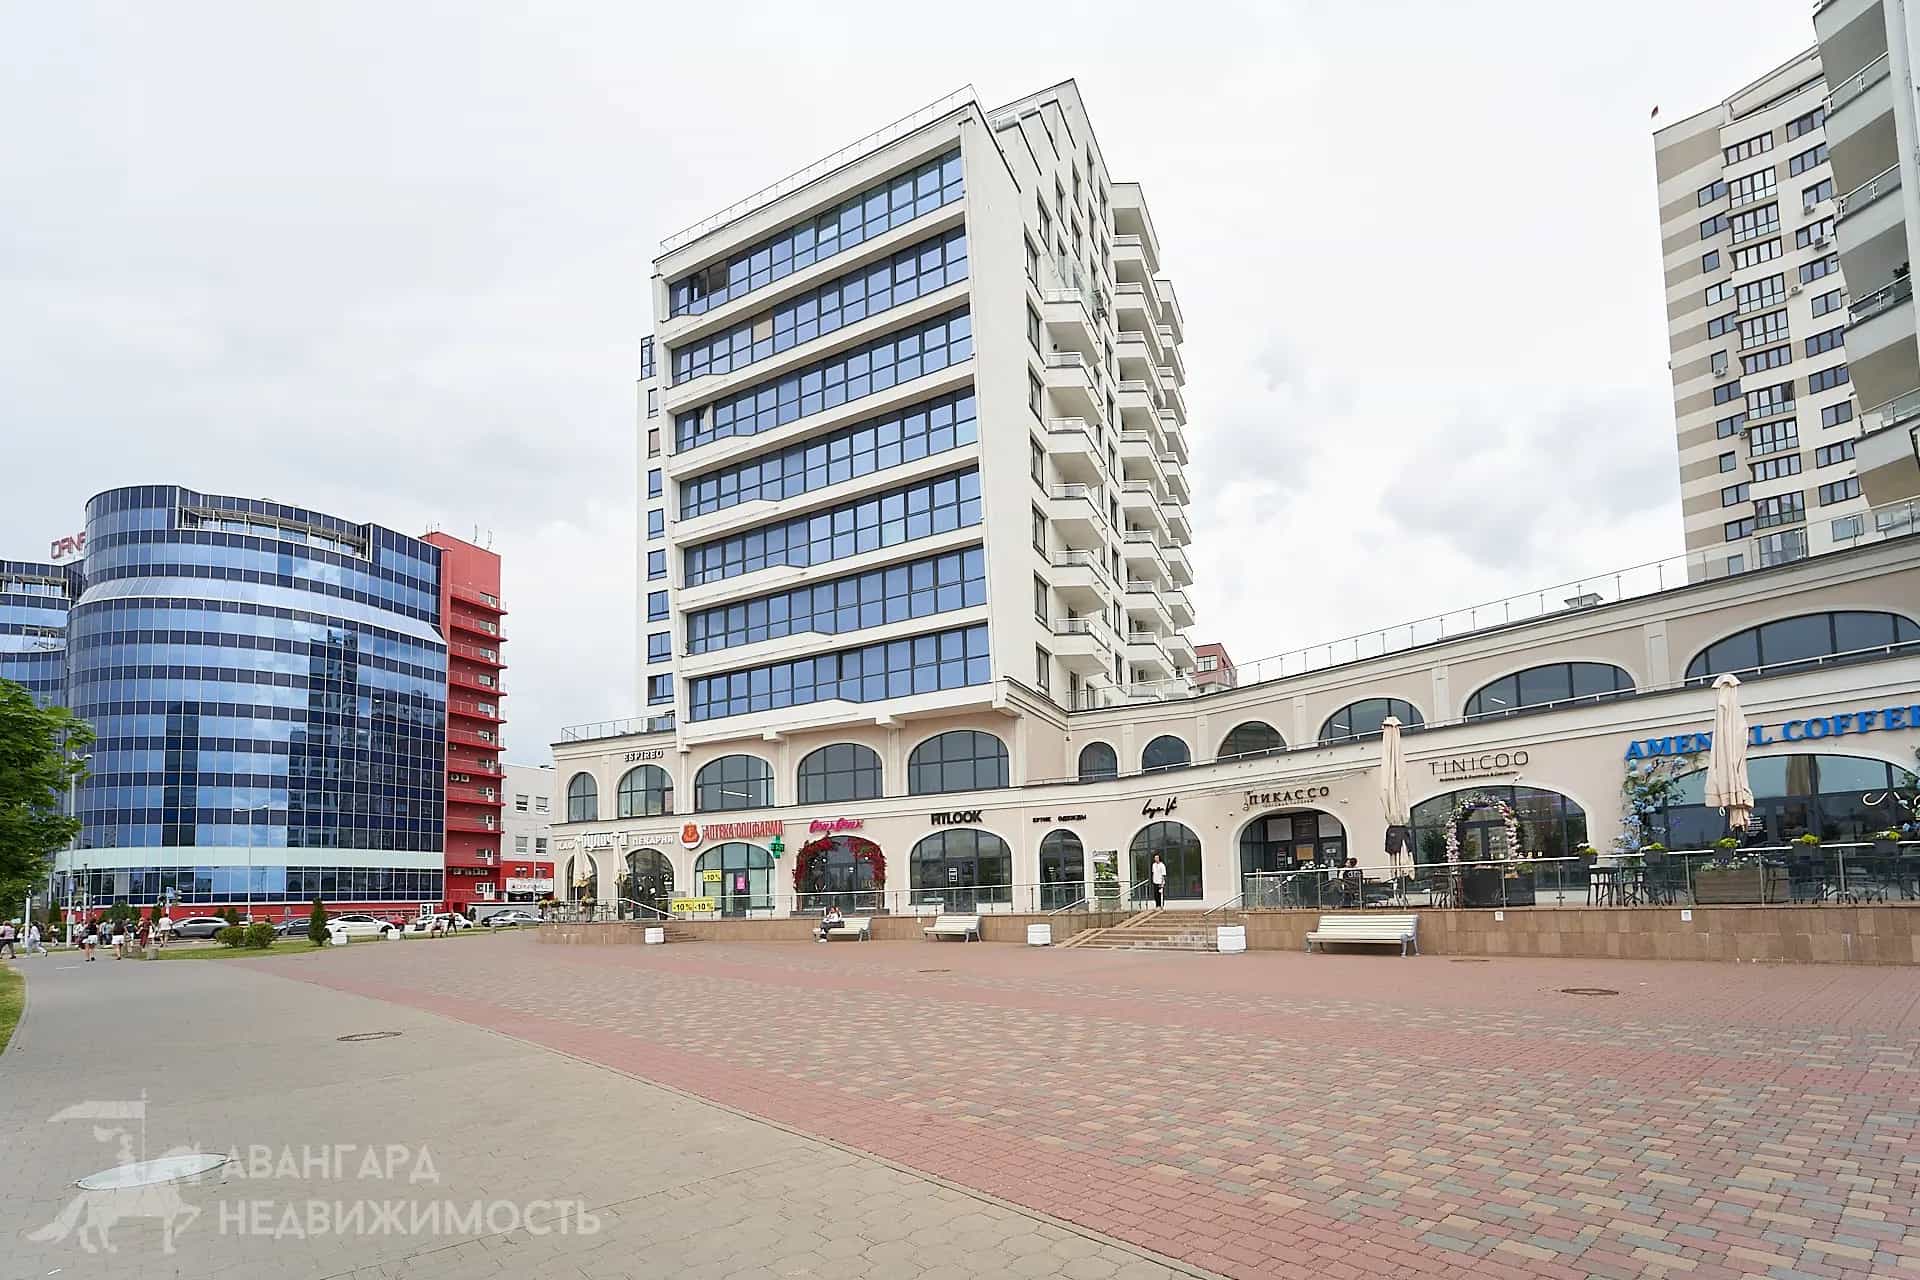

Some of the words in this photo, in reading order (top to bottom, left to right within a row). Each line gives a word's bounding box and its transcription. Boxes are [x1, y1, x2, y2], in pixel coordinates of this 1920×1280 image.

[1624, 724, 1773, 762] AMENL
[1428, 751, 1529, 776] TINICOO
[1249, 786, 1330, 805] ПИКАССО
[931, 810, 983, 825] FITLOOK
